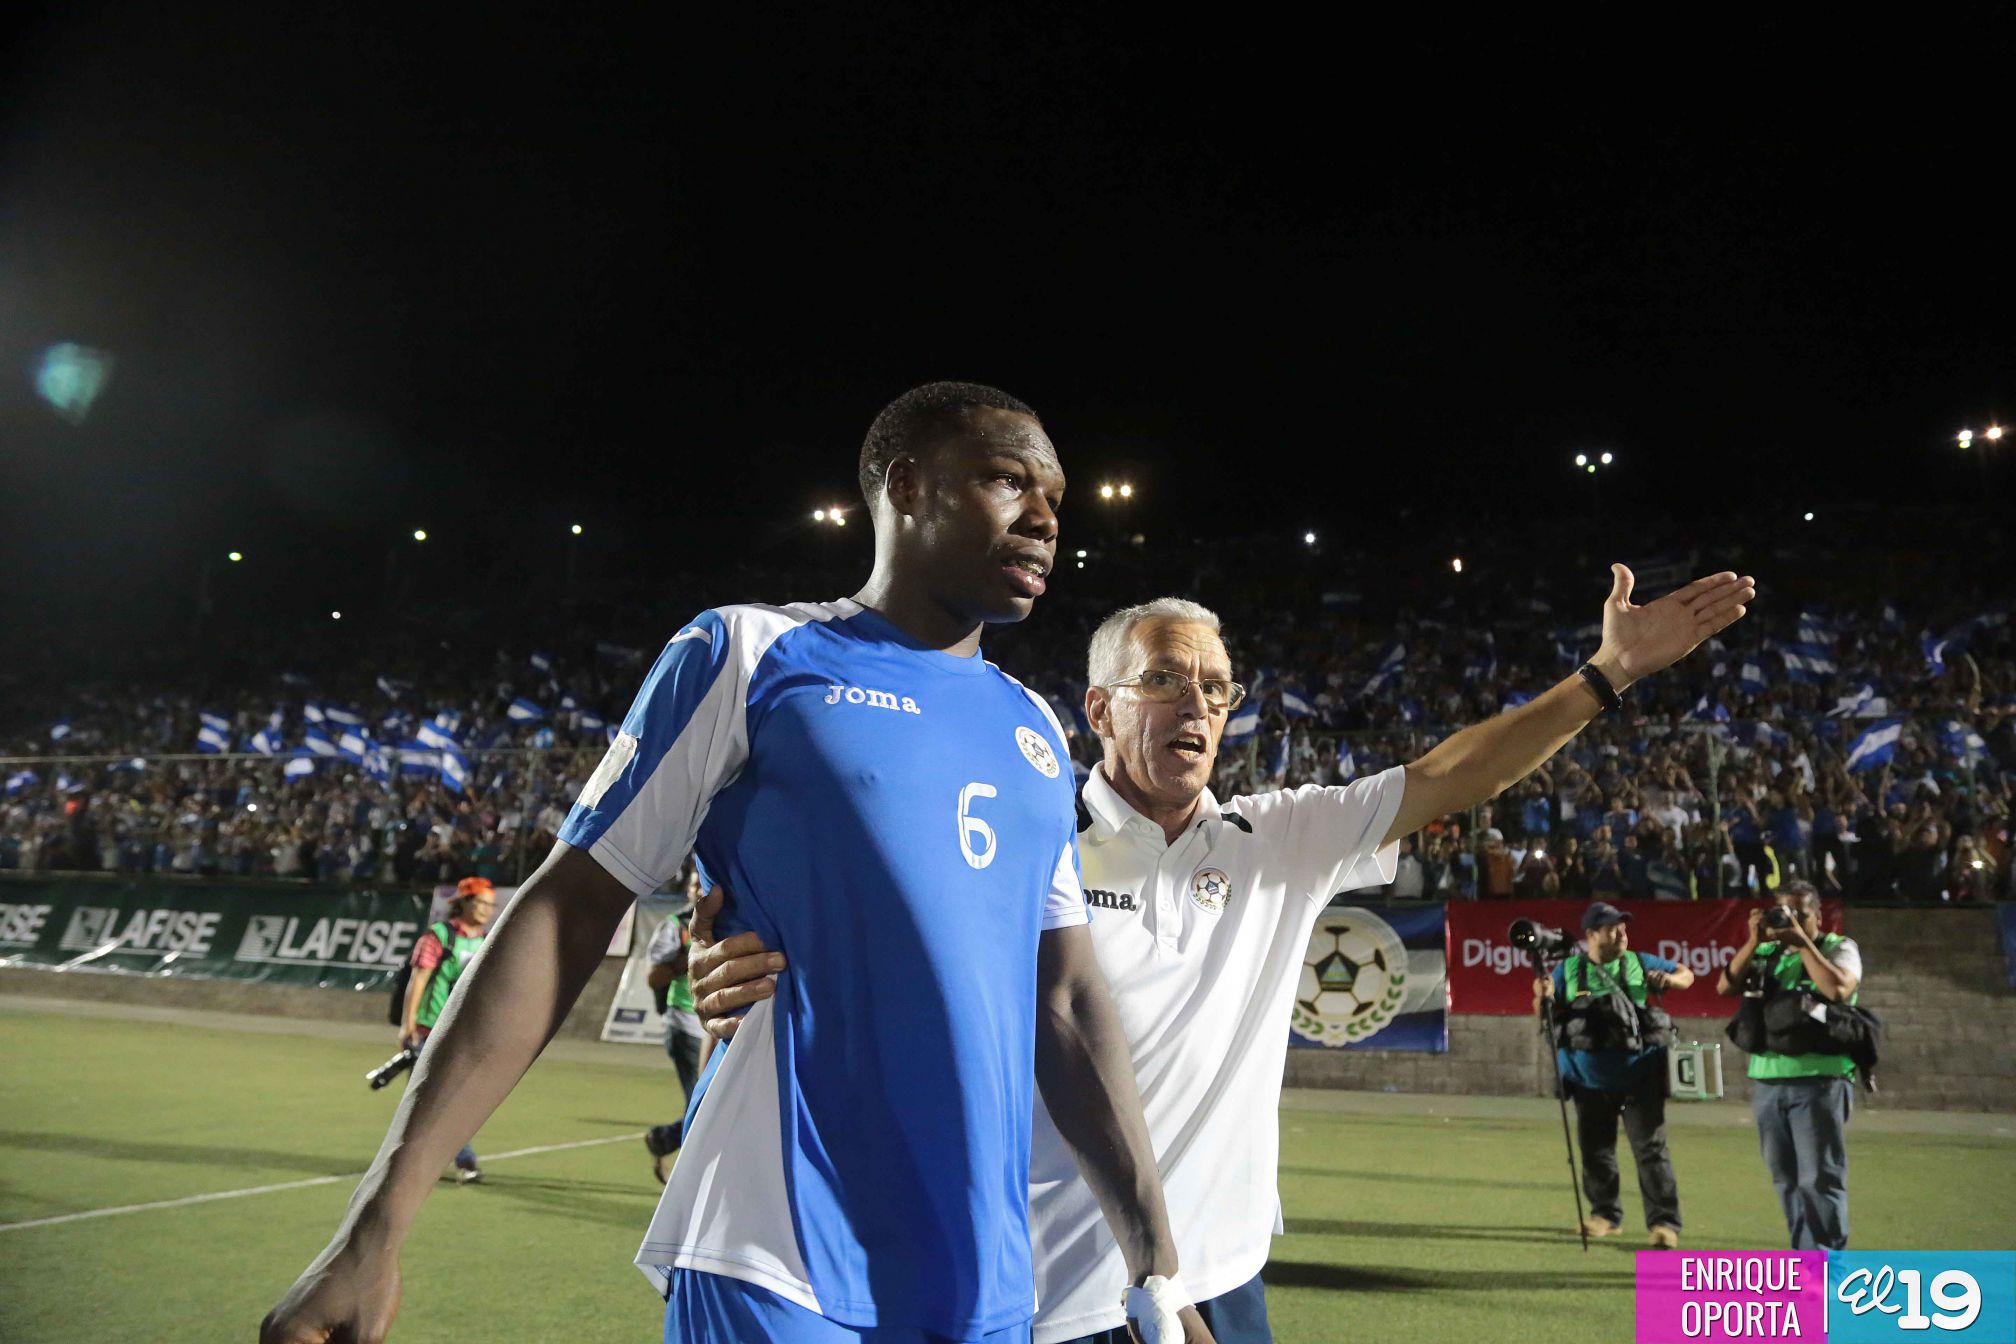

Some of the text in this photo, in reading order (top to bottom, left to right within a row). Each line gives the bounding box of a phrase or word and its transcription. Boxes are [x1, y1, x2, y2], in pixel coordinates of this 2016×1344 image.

[824, 685, 921, 715] Joma
[957, 782, 998, 870] 6
[98, 907, 222, 952] LAFISE
[276, 917, 418, 965] LAFISE
